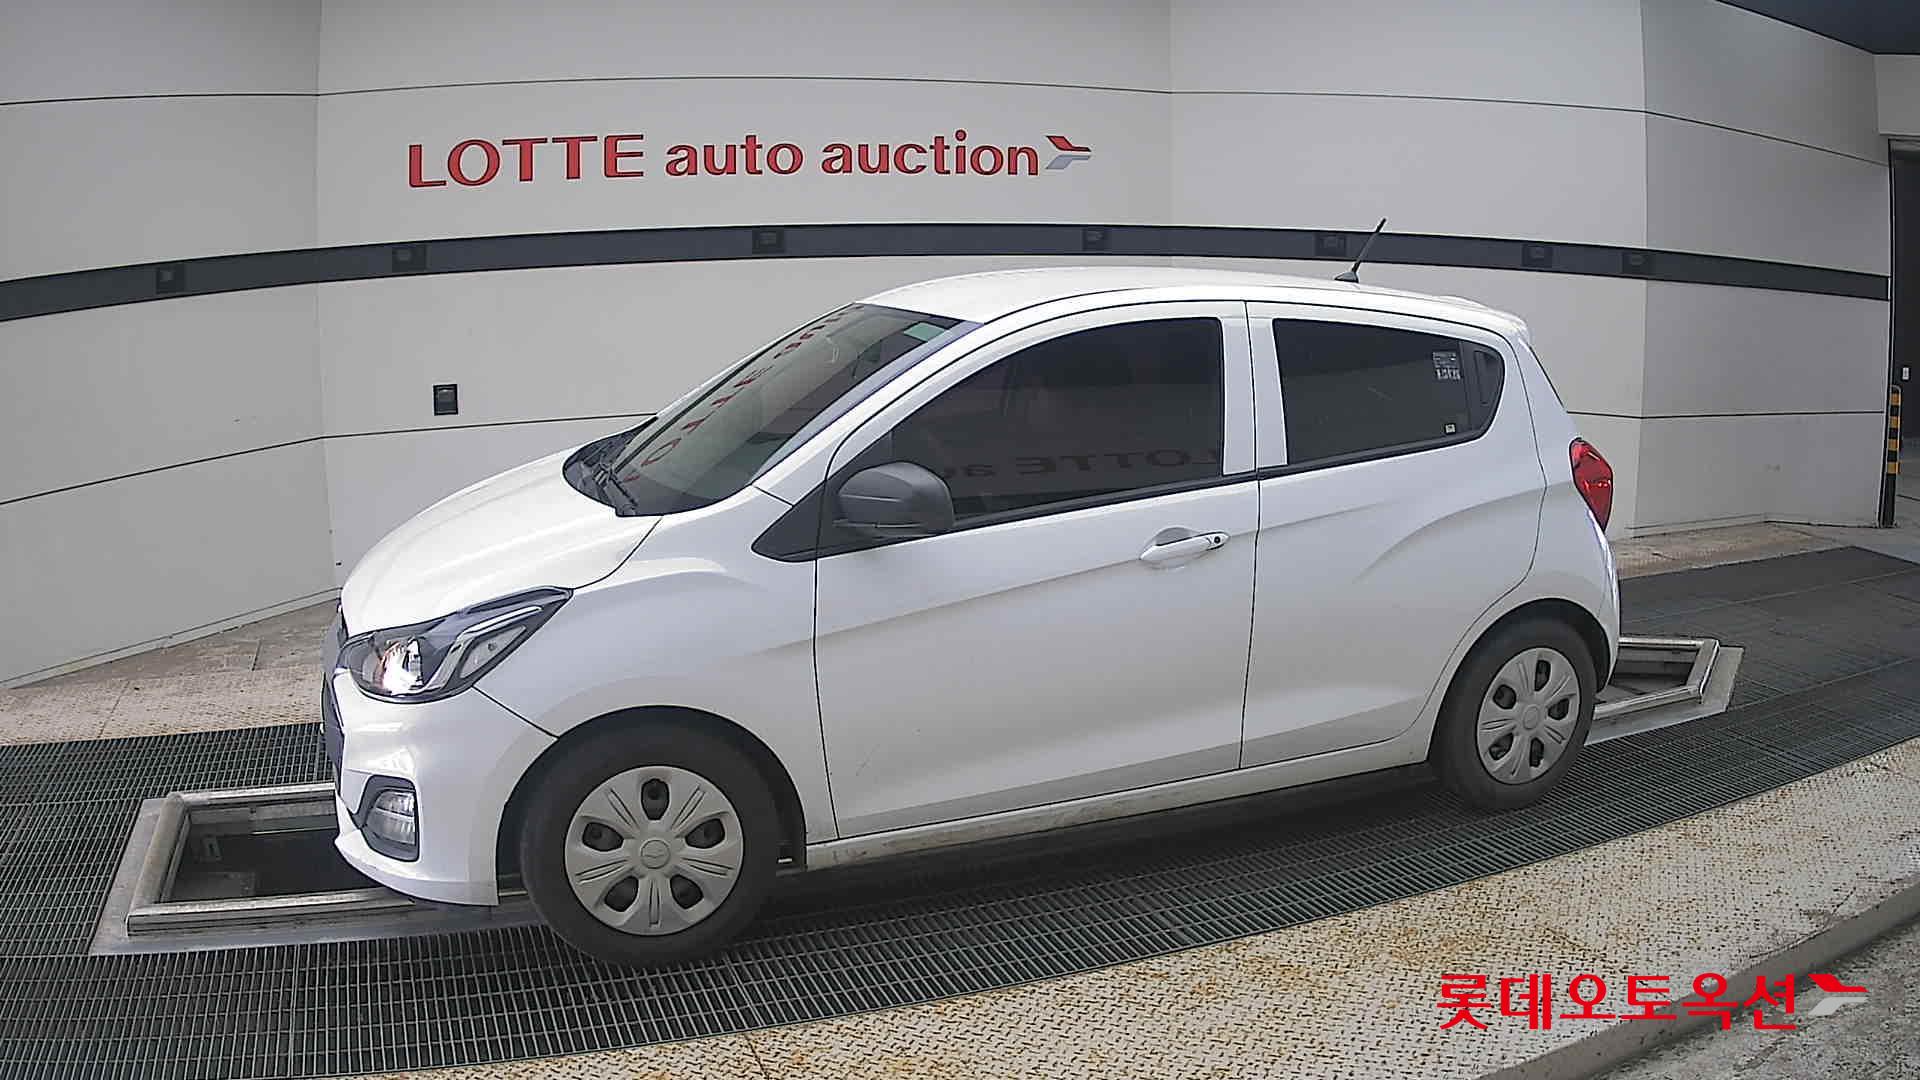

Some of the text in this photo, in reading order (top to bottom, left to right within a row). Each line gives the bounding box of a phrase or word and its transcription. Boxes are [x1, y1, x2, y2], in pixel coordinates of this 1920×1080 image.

[408, 129, 1039, 188] LOTTE auto auction
